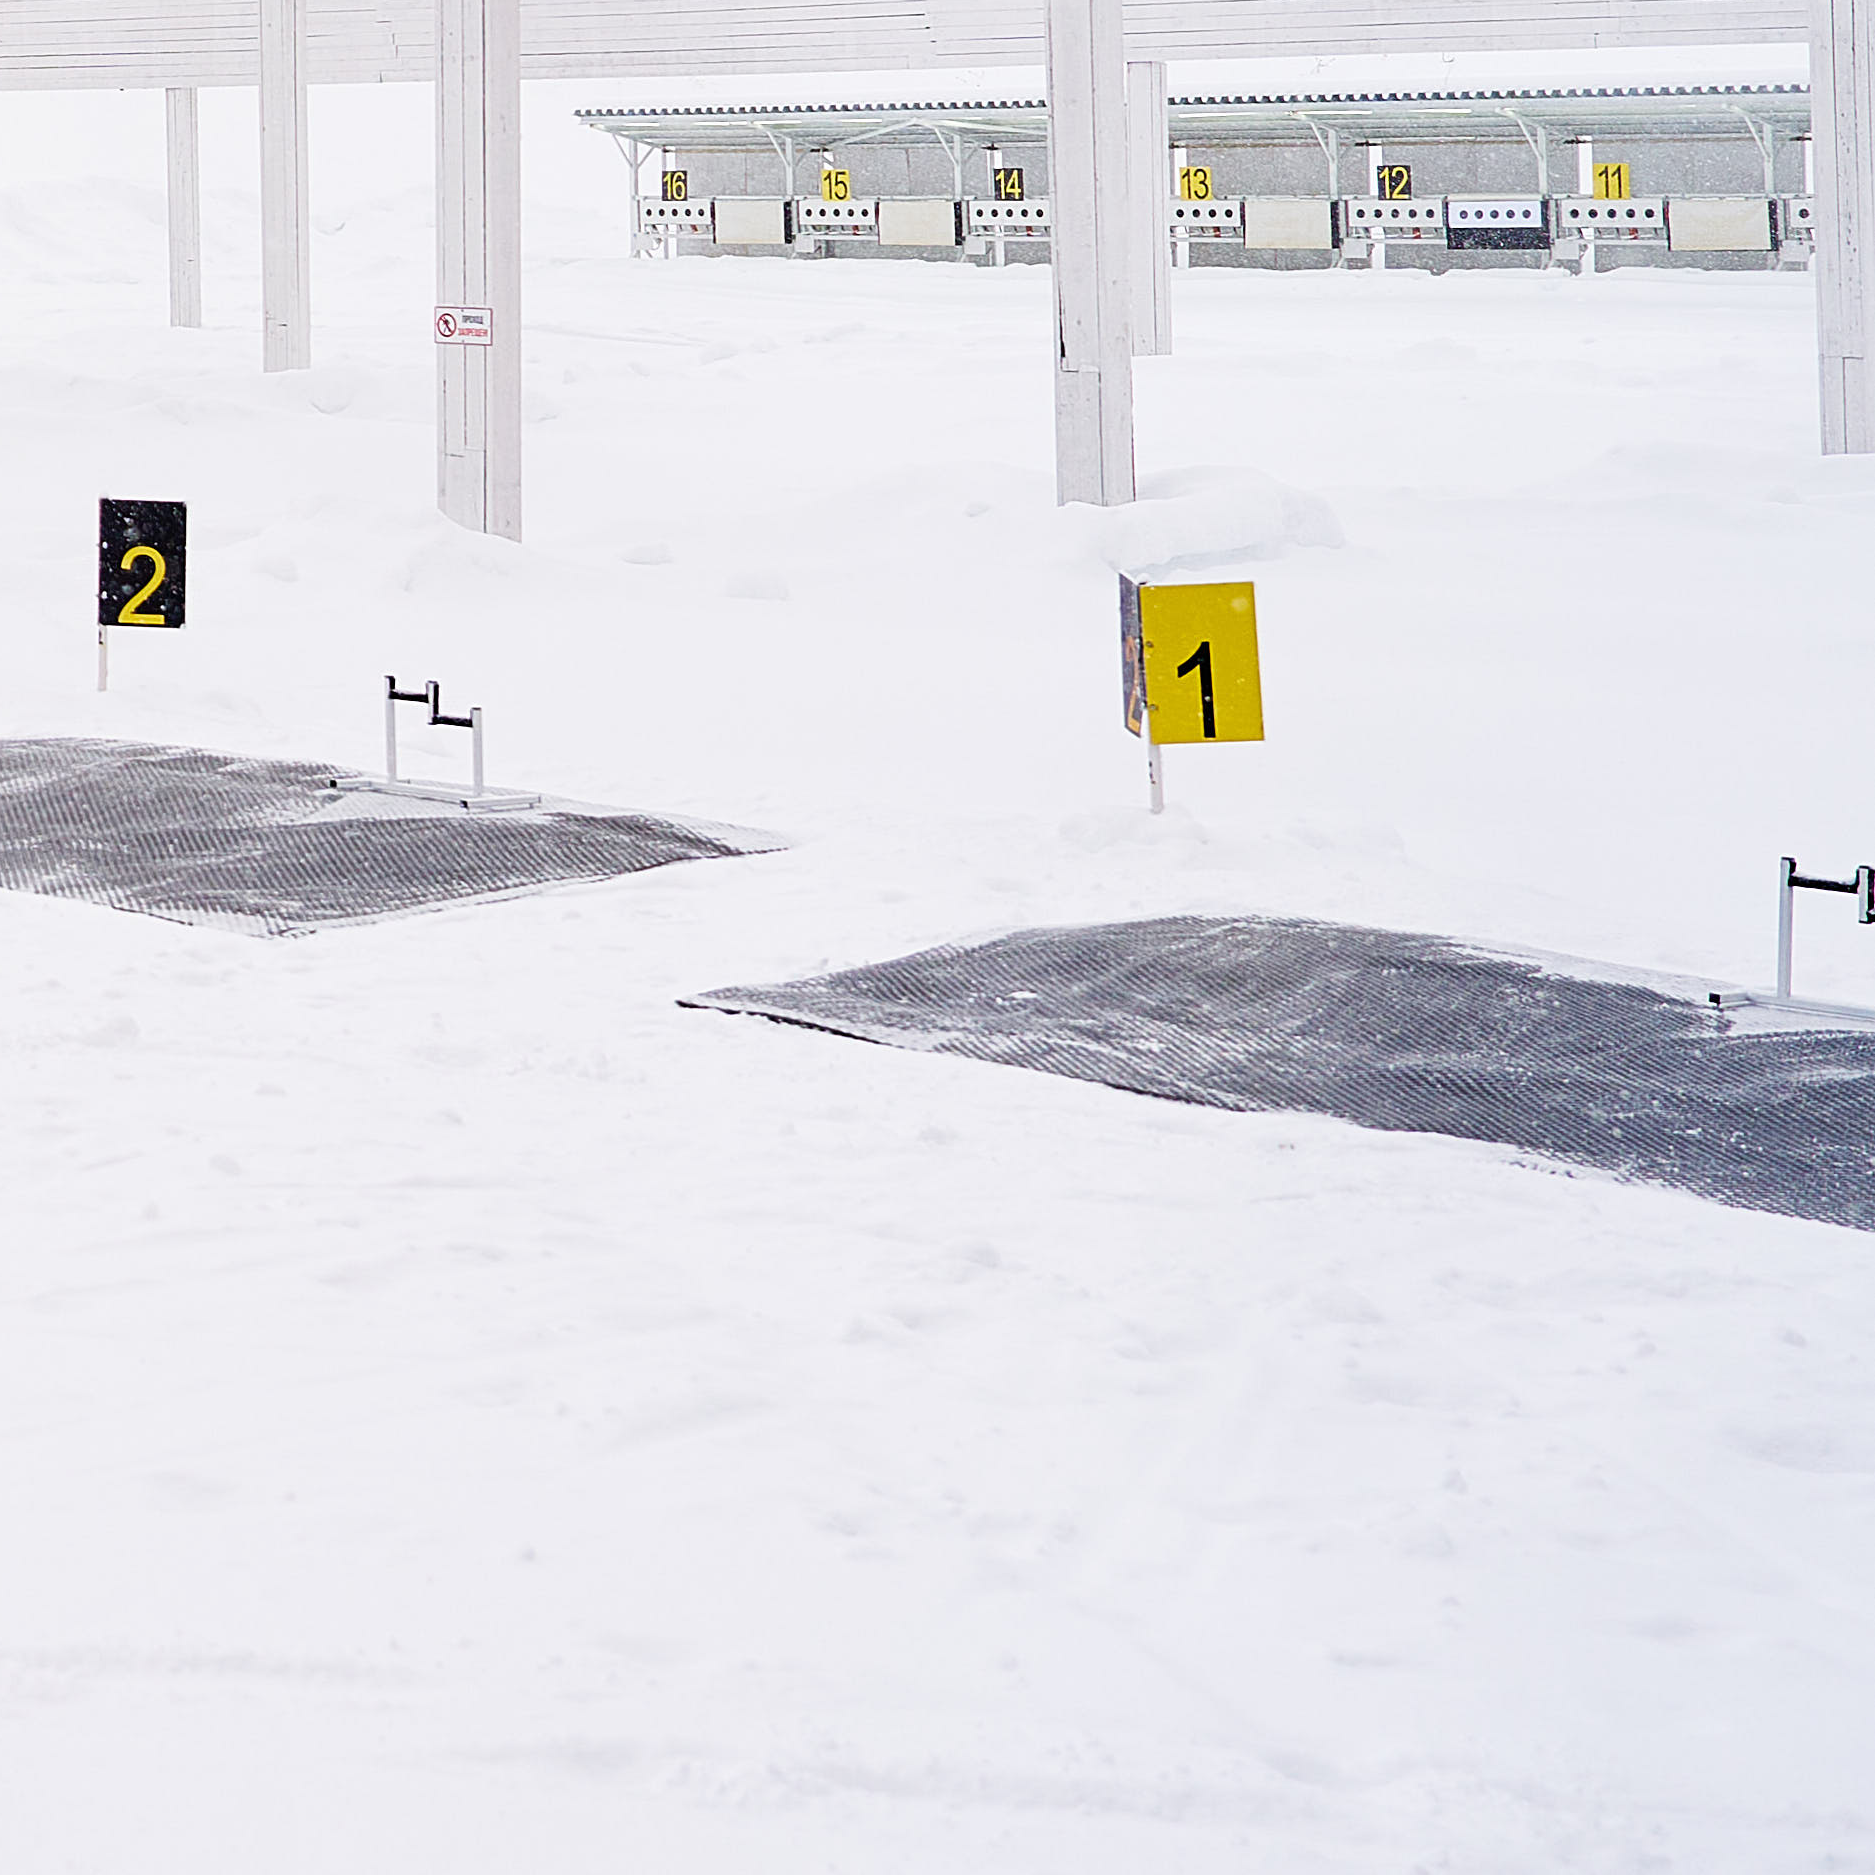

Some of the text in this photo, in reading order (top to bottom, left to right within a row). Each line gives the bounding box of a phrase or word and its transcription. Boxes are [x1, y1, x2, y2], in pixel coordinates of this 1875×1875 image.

[663, 172, 686, 200] 16
[823, 171, 848, 200] 15
[996, 170, 1022, 199] 14
[1182, 168, 1209, 199] 13
[1379, 166, 1410, 199] 12
[1598, 165, 1623, 199] 11
[117, 545, 166, 625] 2
[1176, 640, 1217, 739] 1
